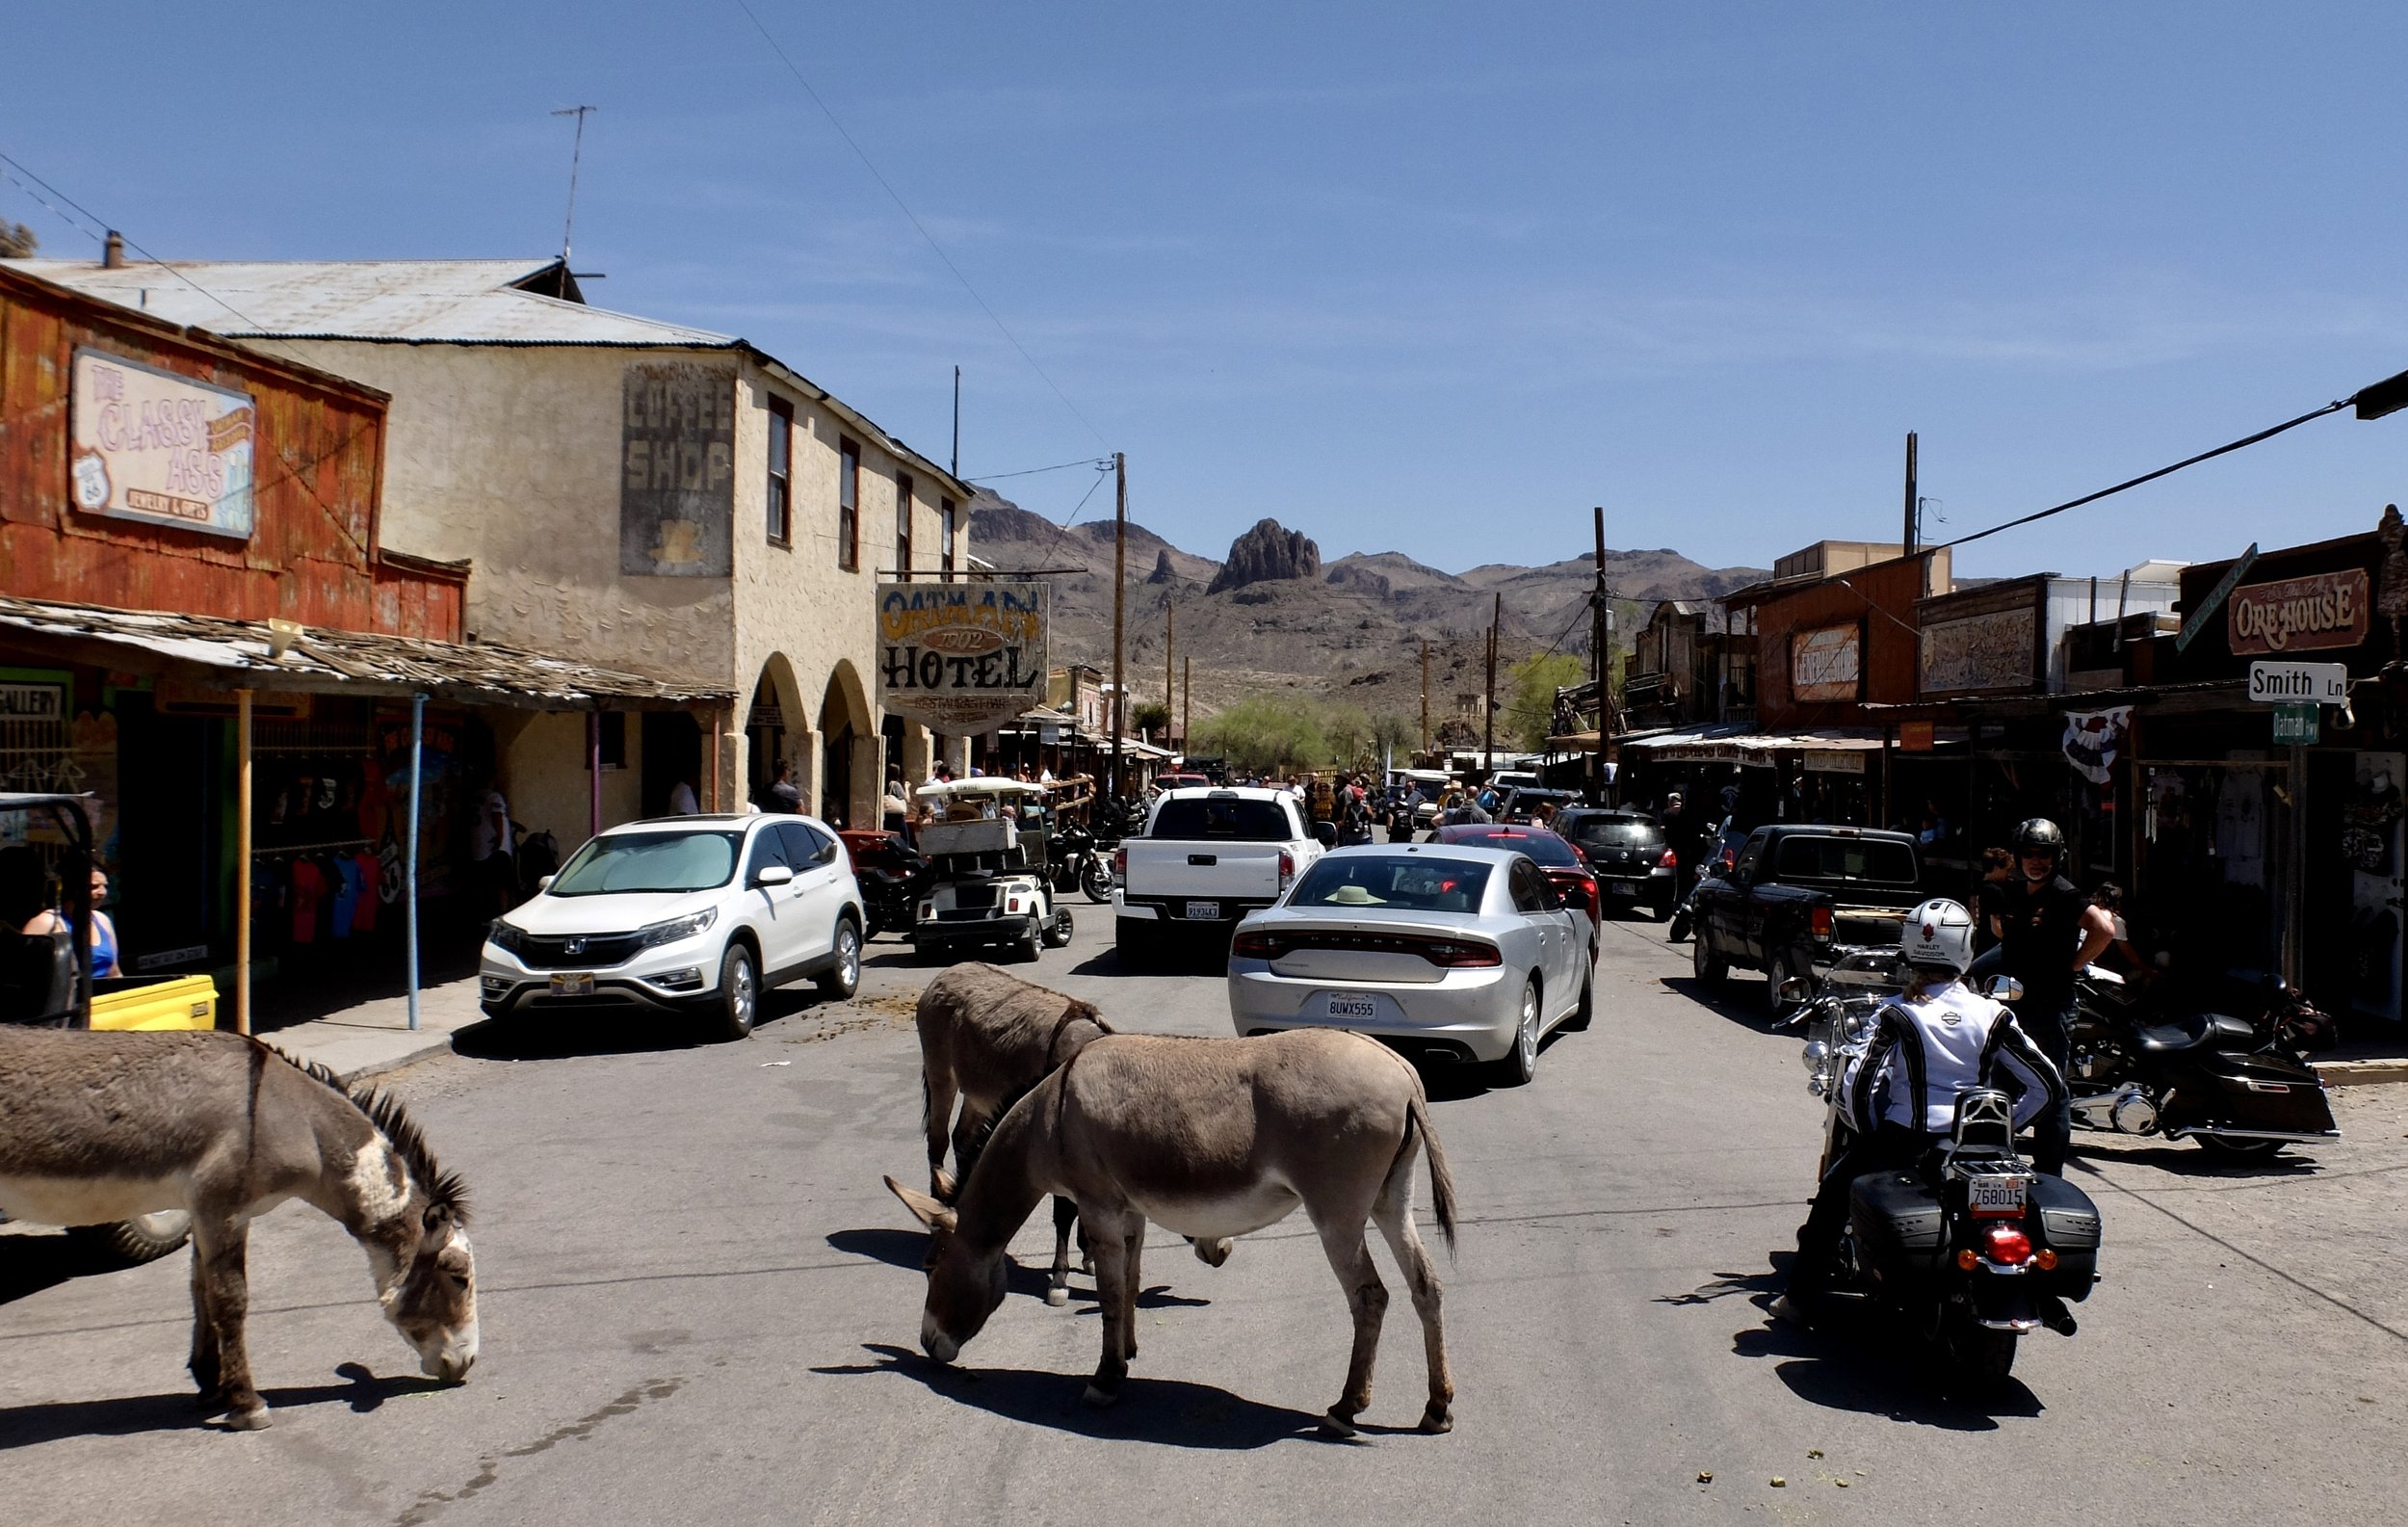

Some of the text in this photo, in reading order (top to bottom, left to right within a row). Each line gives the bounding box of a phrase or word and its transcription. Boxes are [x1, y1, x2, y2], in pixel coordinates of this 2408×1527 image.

[97, 398, 209, 454] CLASSY
[628, 379, 731, 429] COFFEE
[166, 444, 223, 498] ASS
[627, 439, 730, 490] SHOP
[128, 491, 207, 518] JEWELRY & GIFTS
[882, 590, 1039, 642] OATMAN
[2279, 583, 2356, 634] HOUSE
[937, 632, 985, 649] 1902
[1795, 640, 1858, 685] GENERAL STORE
[881, 646, 1039, 690] HOTEL
[2253, 668, 2343, 697] Smith Ln
[2273, 712, 2304, 737] Oatman
[1913, 949, 1946, 958] DAVIDSON
[1329, 1001, 1374, 1015] 8UWX555
